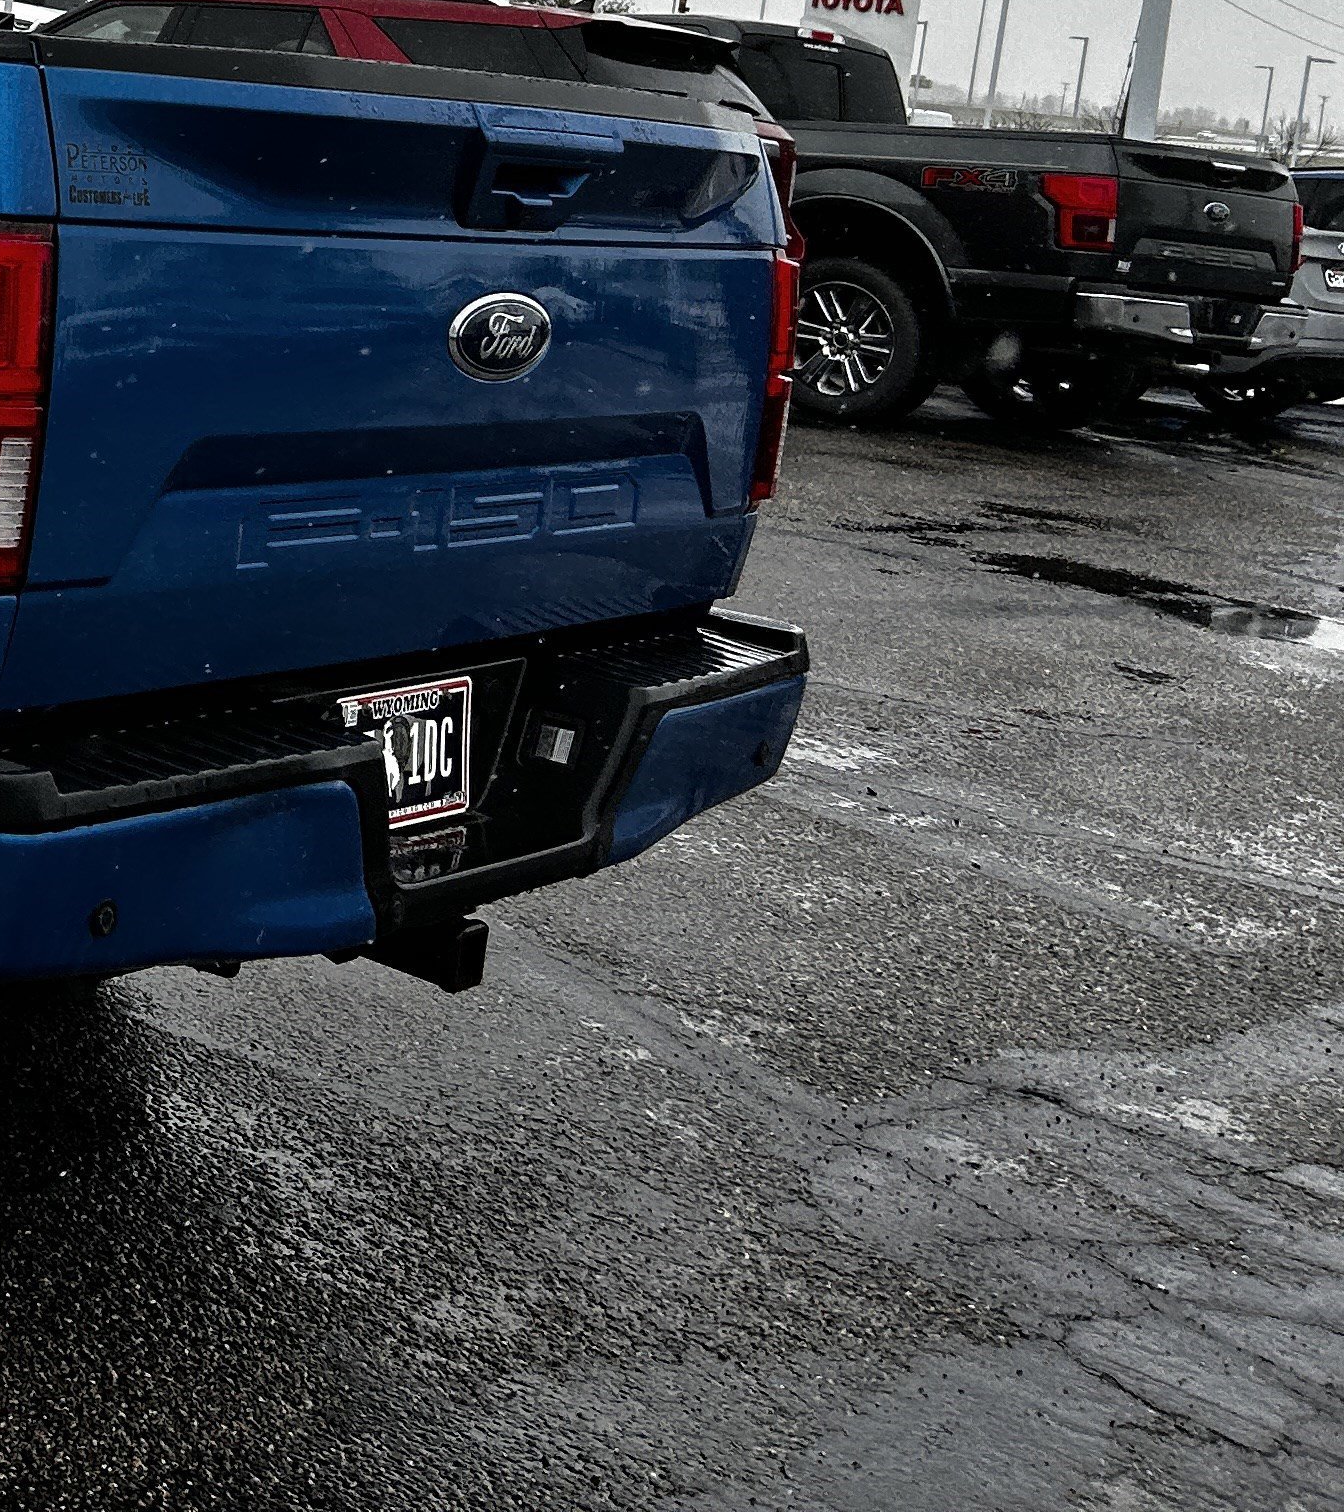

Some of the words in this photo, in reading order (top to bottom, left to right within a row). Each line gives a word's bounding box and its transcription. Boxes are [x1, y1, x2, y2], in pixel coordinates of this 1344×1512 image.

[67, 143, 148, 175] PETERSON
[921, 166, 1018, 190] FX4
[479, 312, 537, 360] Ford
[372, 690, 439, 719] WYOMING
